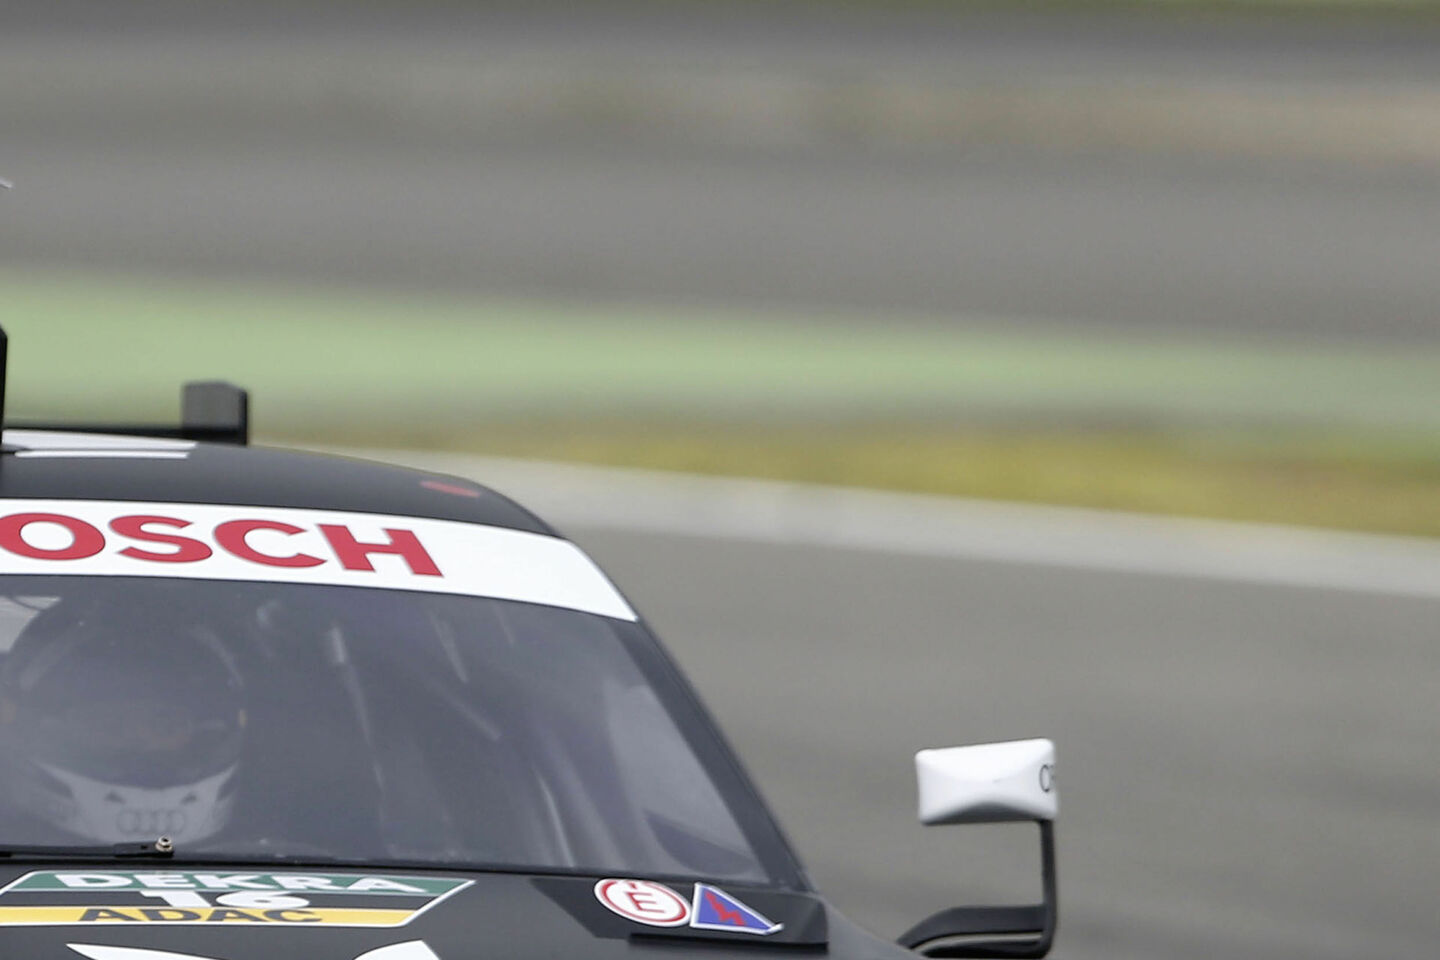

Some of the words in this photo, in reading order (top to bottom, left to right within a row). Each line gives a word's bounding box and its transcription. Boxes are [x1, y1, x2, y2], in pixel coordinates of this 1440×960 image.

[54, 874, 428, 893] DEKRA
[140, 890, 310, 909] 16
[78, 908, 323, 923] ADAC
